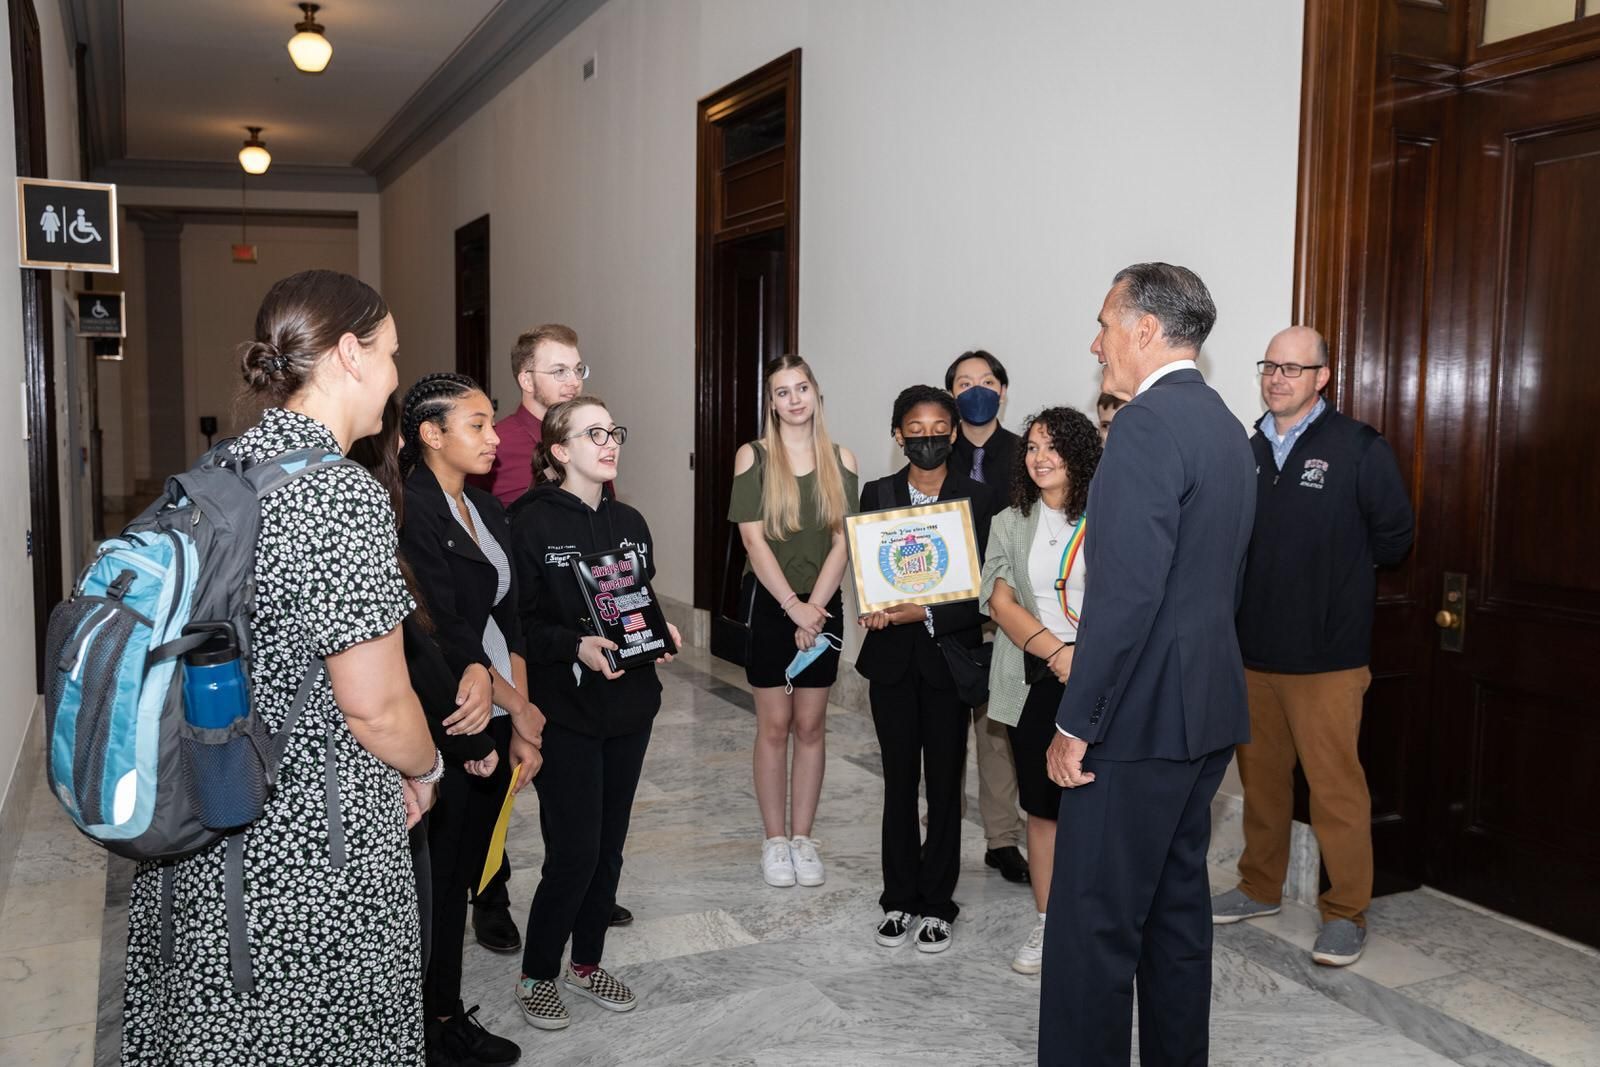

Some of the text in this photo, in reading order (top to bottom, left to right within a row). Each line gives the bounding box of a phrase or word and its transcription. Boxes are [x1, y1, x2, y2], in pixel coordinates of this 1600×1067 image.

[591, 560, 633, 579] Always Our
[599, 576, 635, 592] Governor
[624, 629, 653, 643] Thank you
[619, 639, 665, 659] Senator Romney
